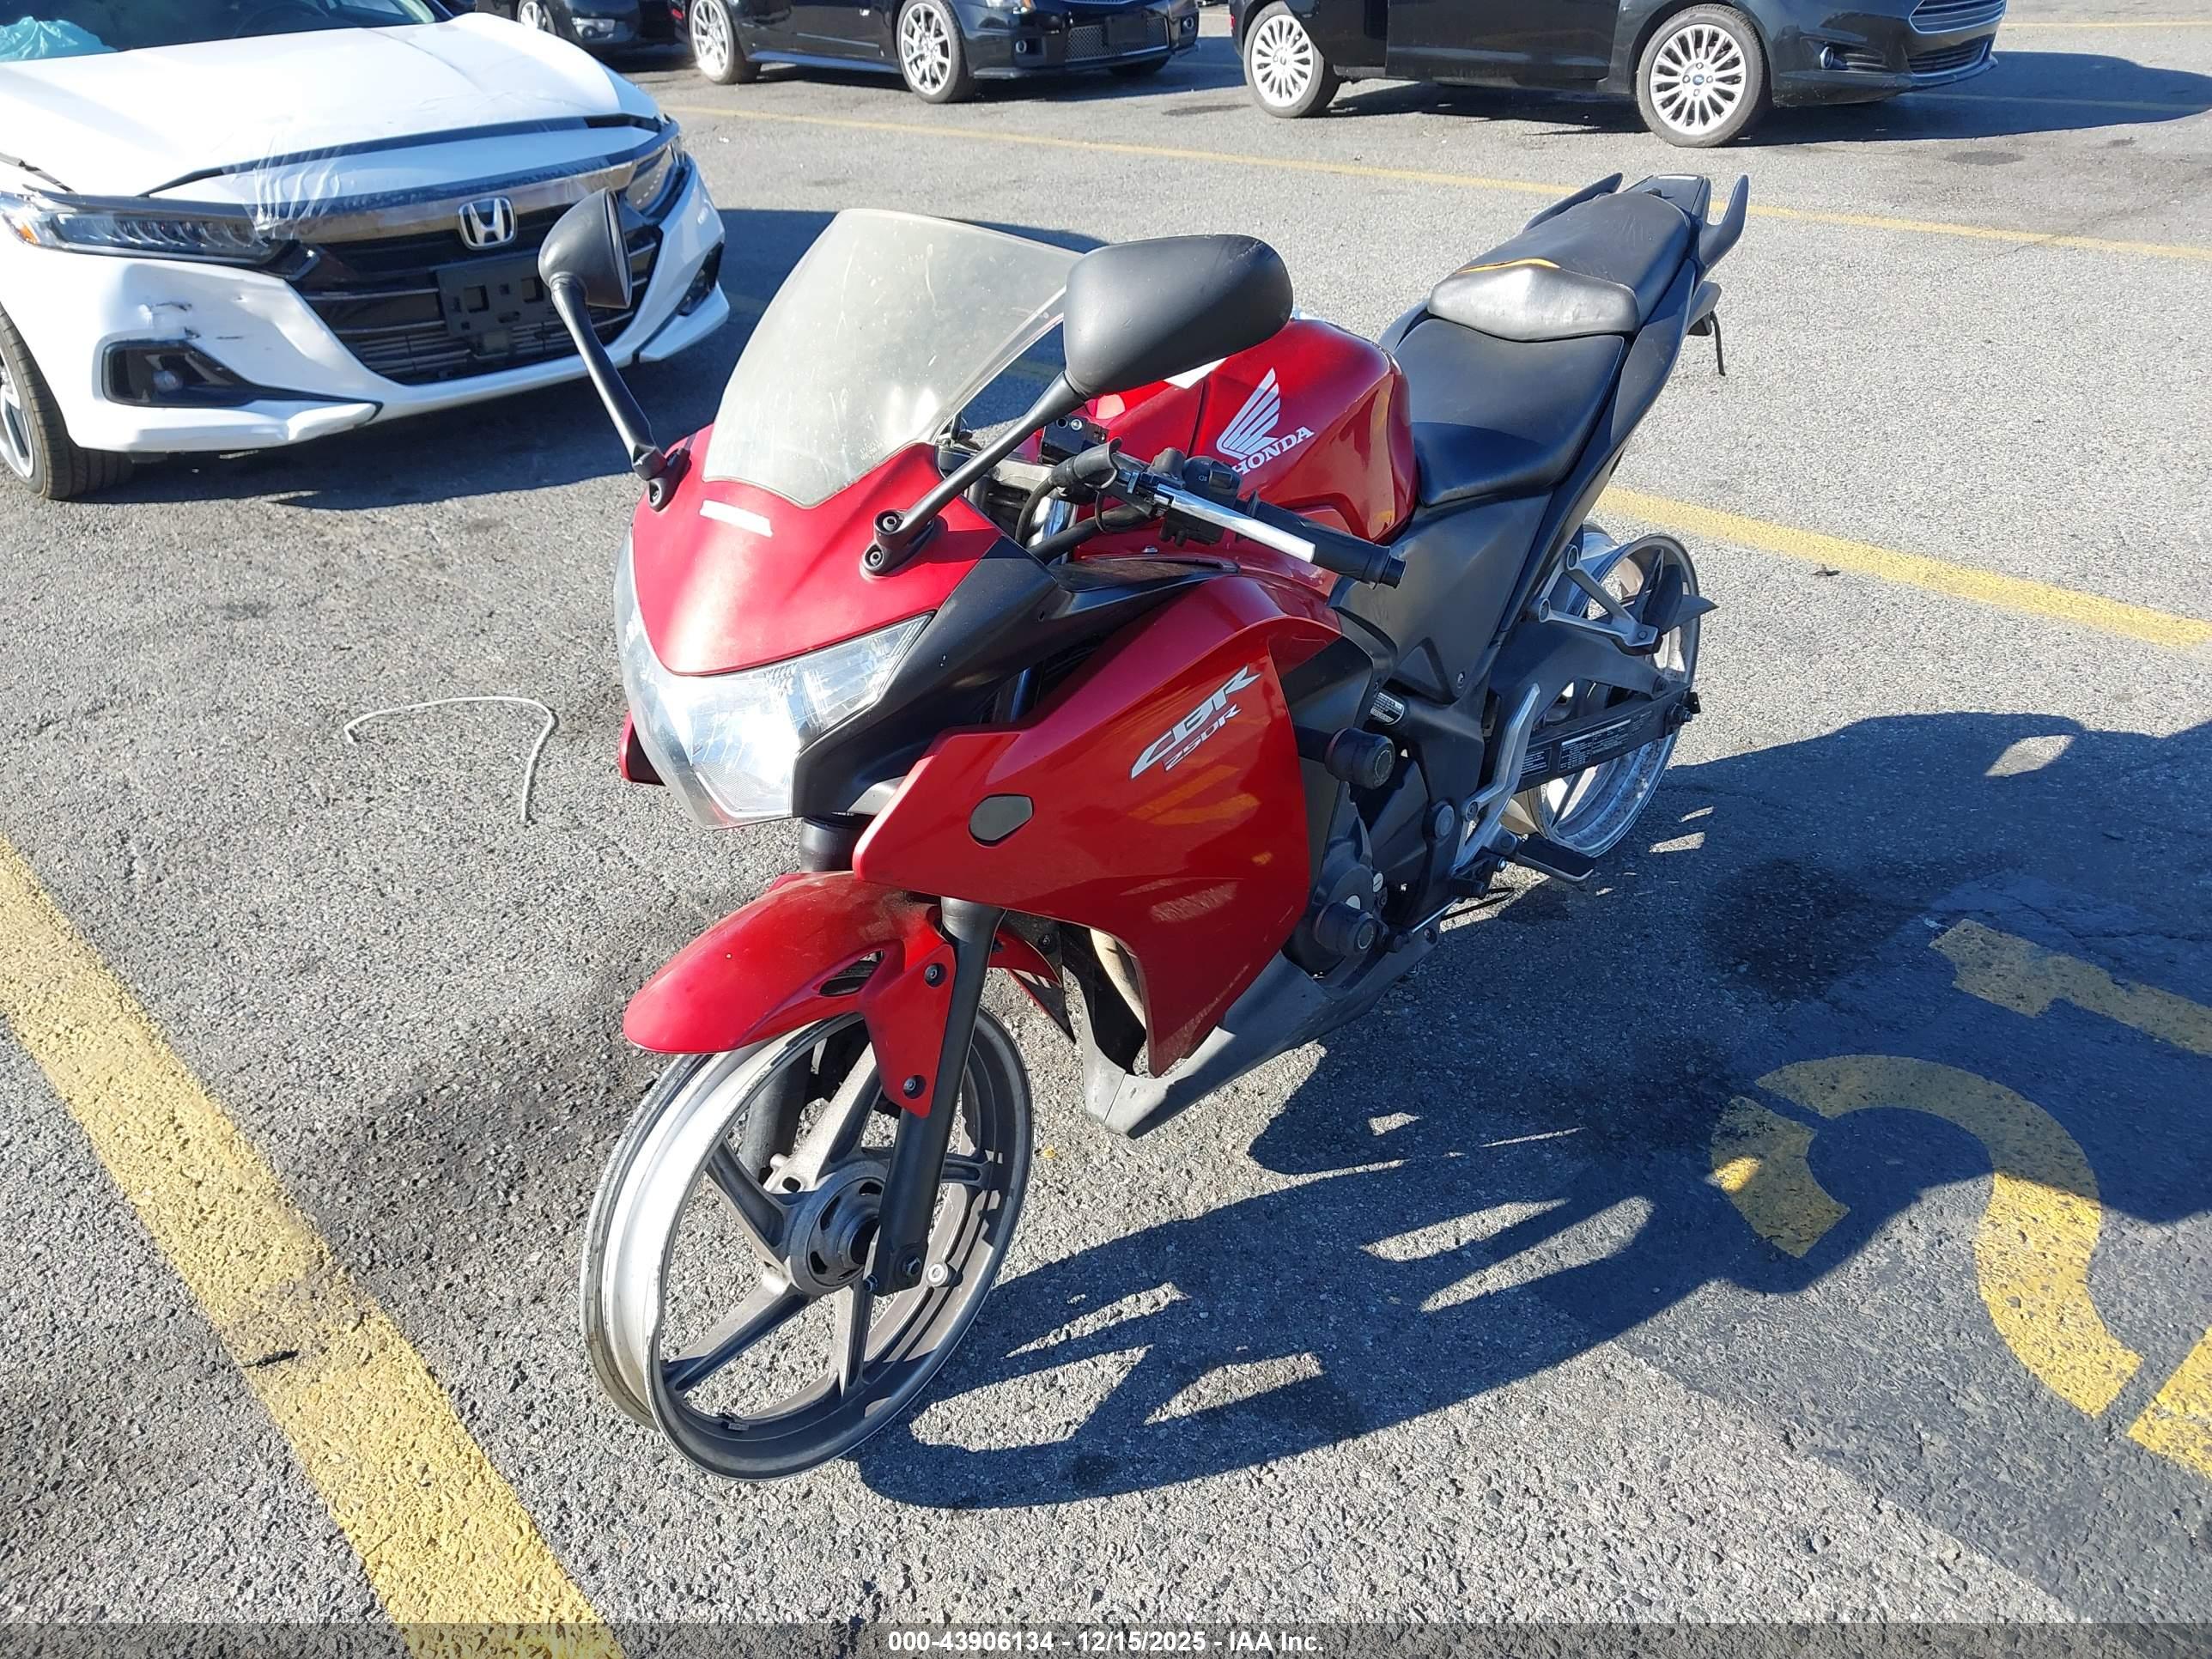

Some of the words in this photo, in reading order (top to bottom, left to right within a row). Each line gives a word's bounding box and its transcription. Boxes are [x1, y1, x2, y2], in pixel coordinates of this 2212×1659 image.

[1231, 426, 1316, 475] HONDA
[1129, 665, 1261, 781] CBR
[1163, 702, 1243, 772] 250R
